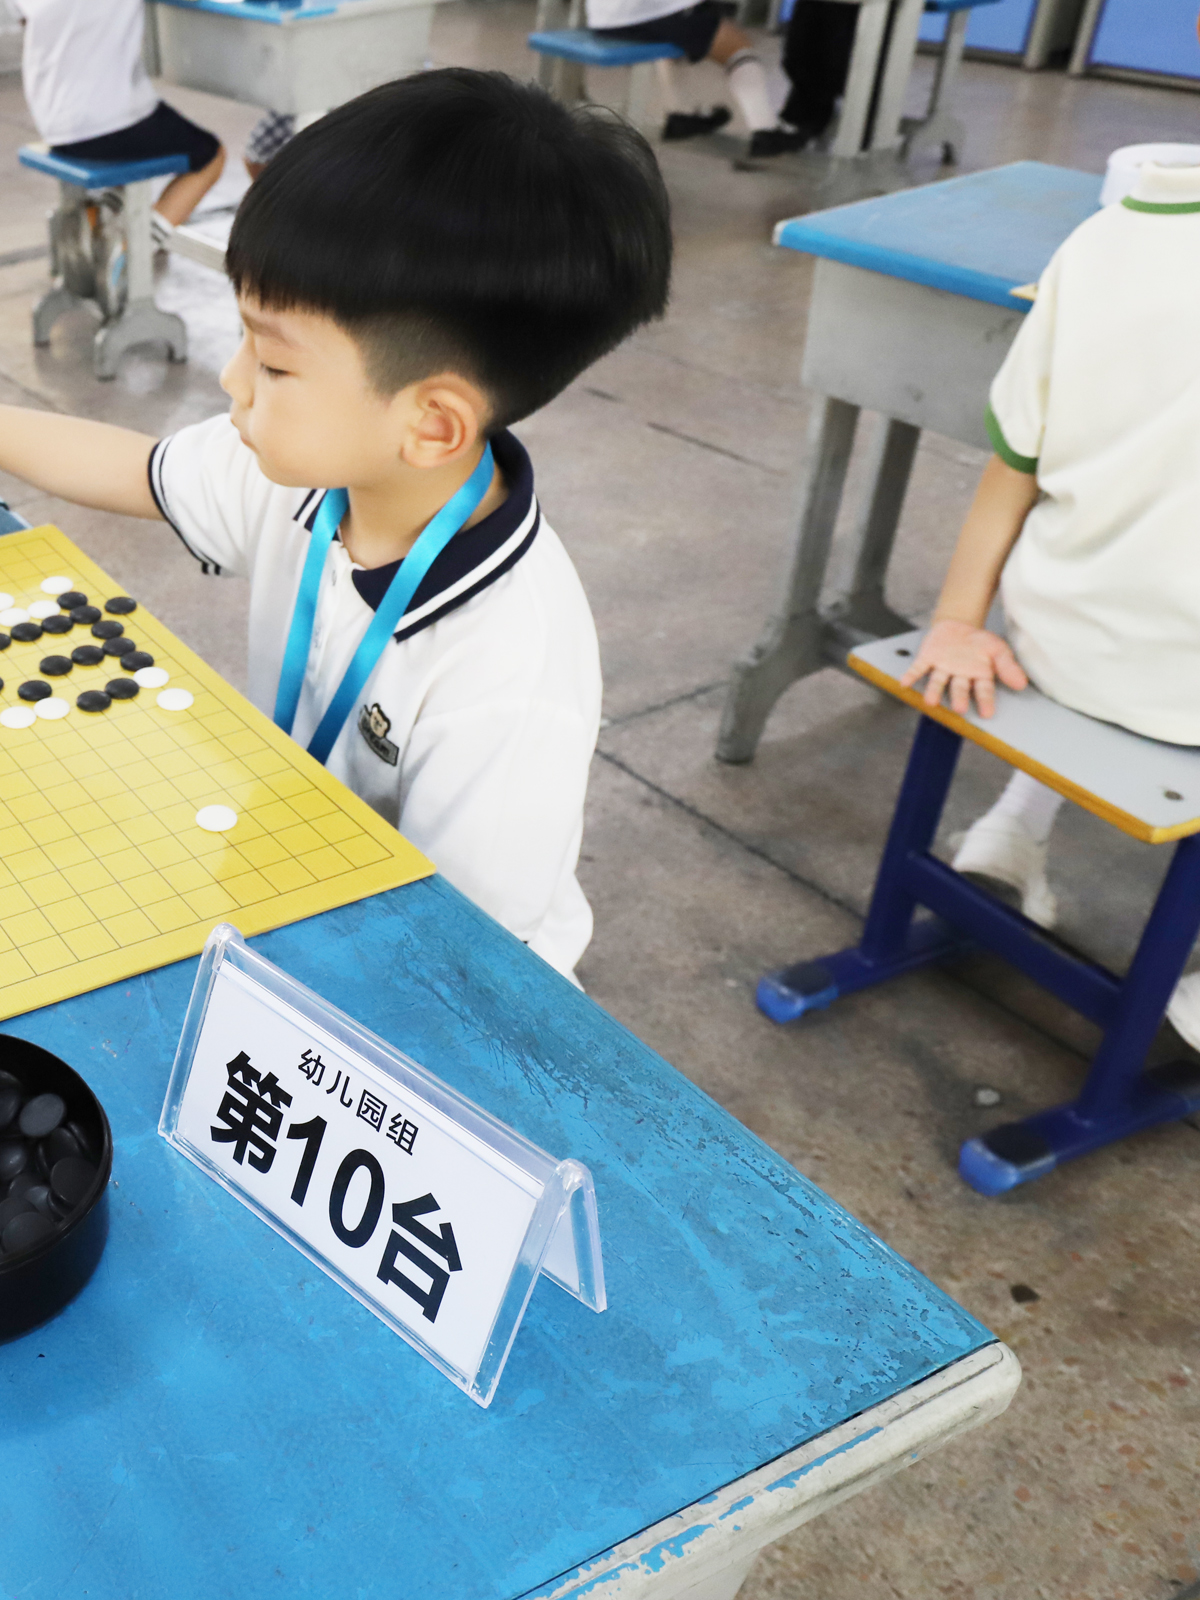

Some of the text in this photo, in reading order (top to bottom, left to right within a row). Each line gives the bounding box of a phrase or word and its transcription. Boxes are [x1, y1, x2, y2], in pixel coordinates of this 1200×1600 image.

[210, 1051, 463, 1323] 第10台
[298, 1049, 419, 1155] 幼儿园组
